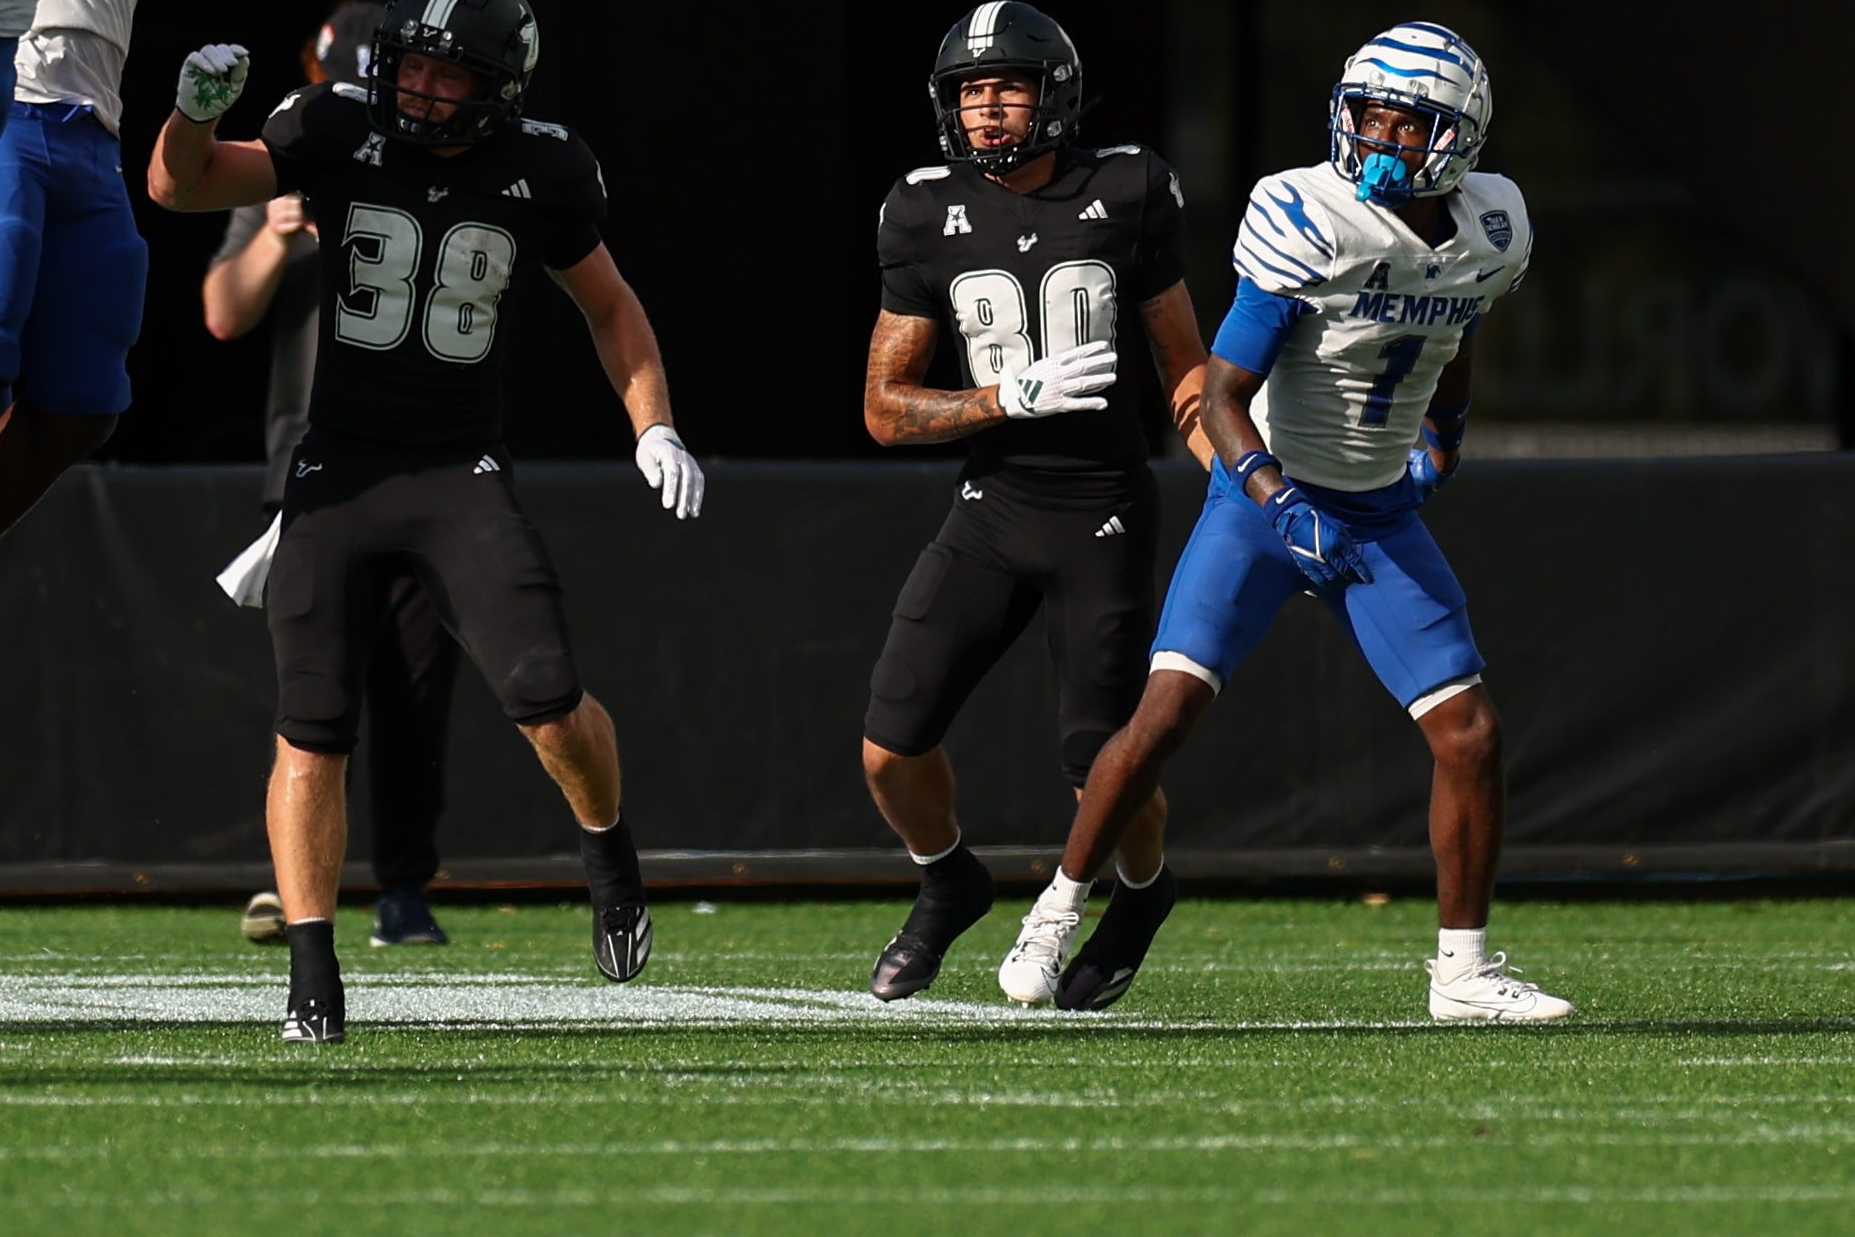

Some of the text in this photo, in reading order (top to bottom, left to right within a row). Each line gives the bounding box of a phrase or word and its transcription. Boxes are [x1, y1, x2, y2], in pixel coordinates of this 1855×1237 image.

[335, 201, 518, 364] 38
[949, 258, 1118, 389] 80
[1349, 289, 1486, 326] MEMPHIS
[1357, 334, 1428, 429] 1
